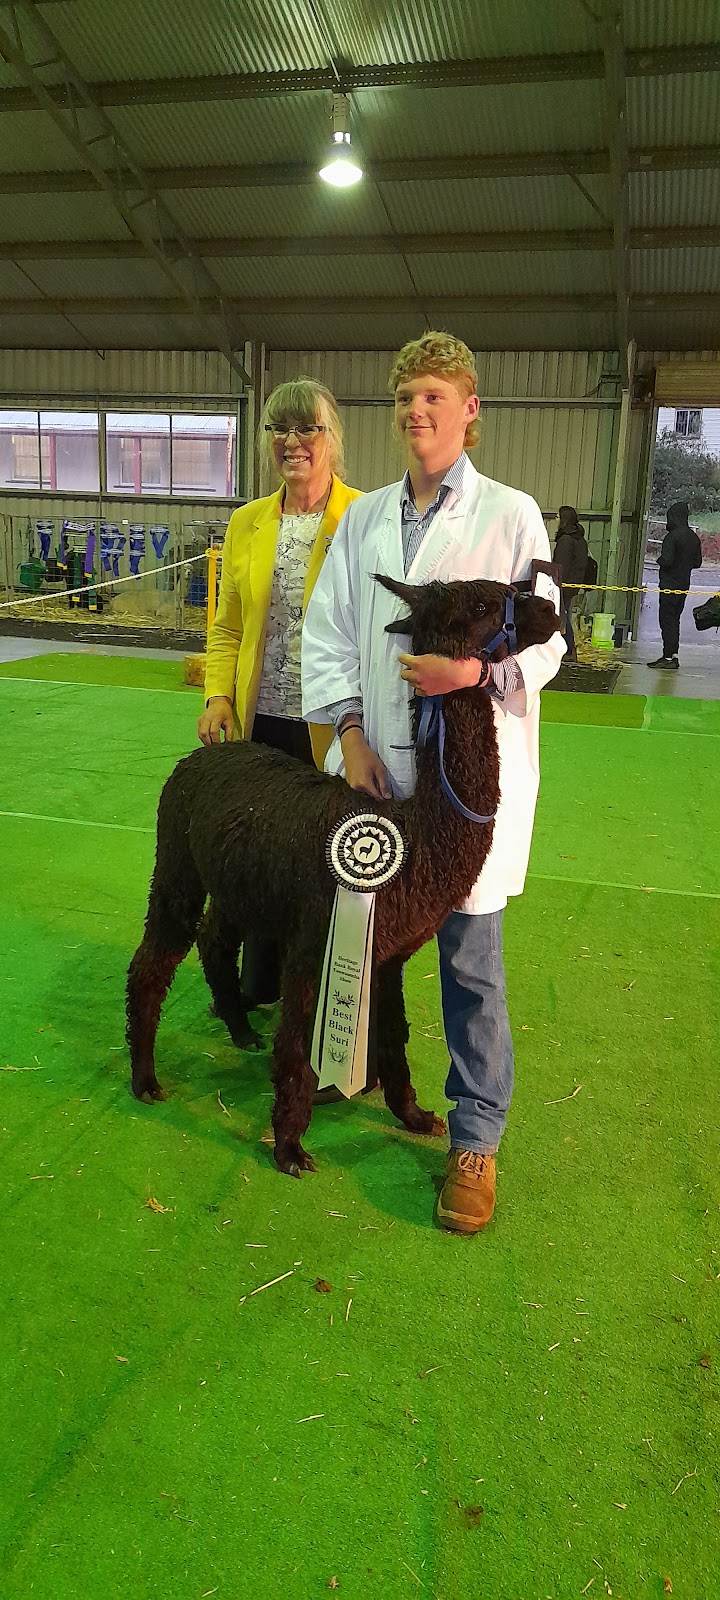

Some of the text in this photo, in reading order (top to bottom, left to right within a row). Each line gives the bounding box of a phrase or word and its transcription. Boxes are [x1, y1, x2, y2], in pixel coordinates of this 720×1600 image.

[332, 1007, 352, 1022] Best
[328, 1019, 354, 1036] Black
[330, 1033, 349, 1047] Suri
